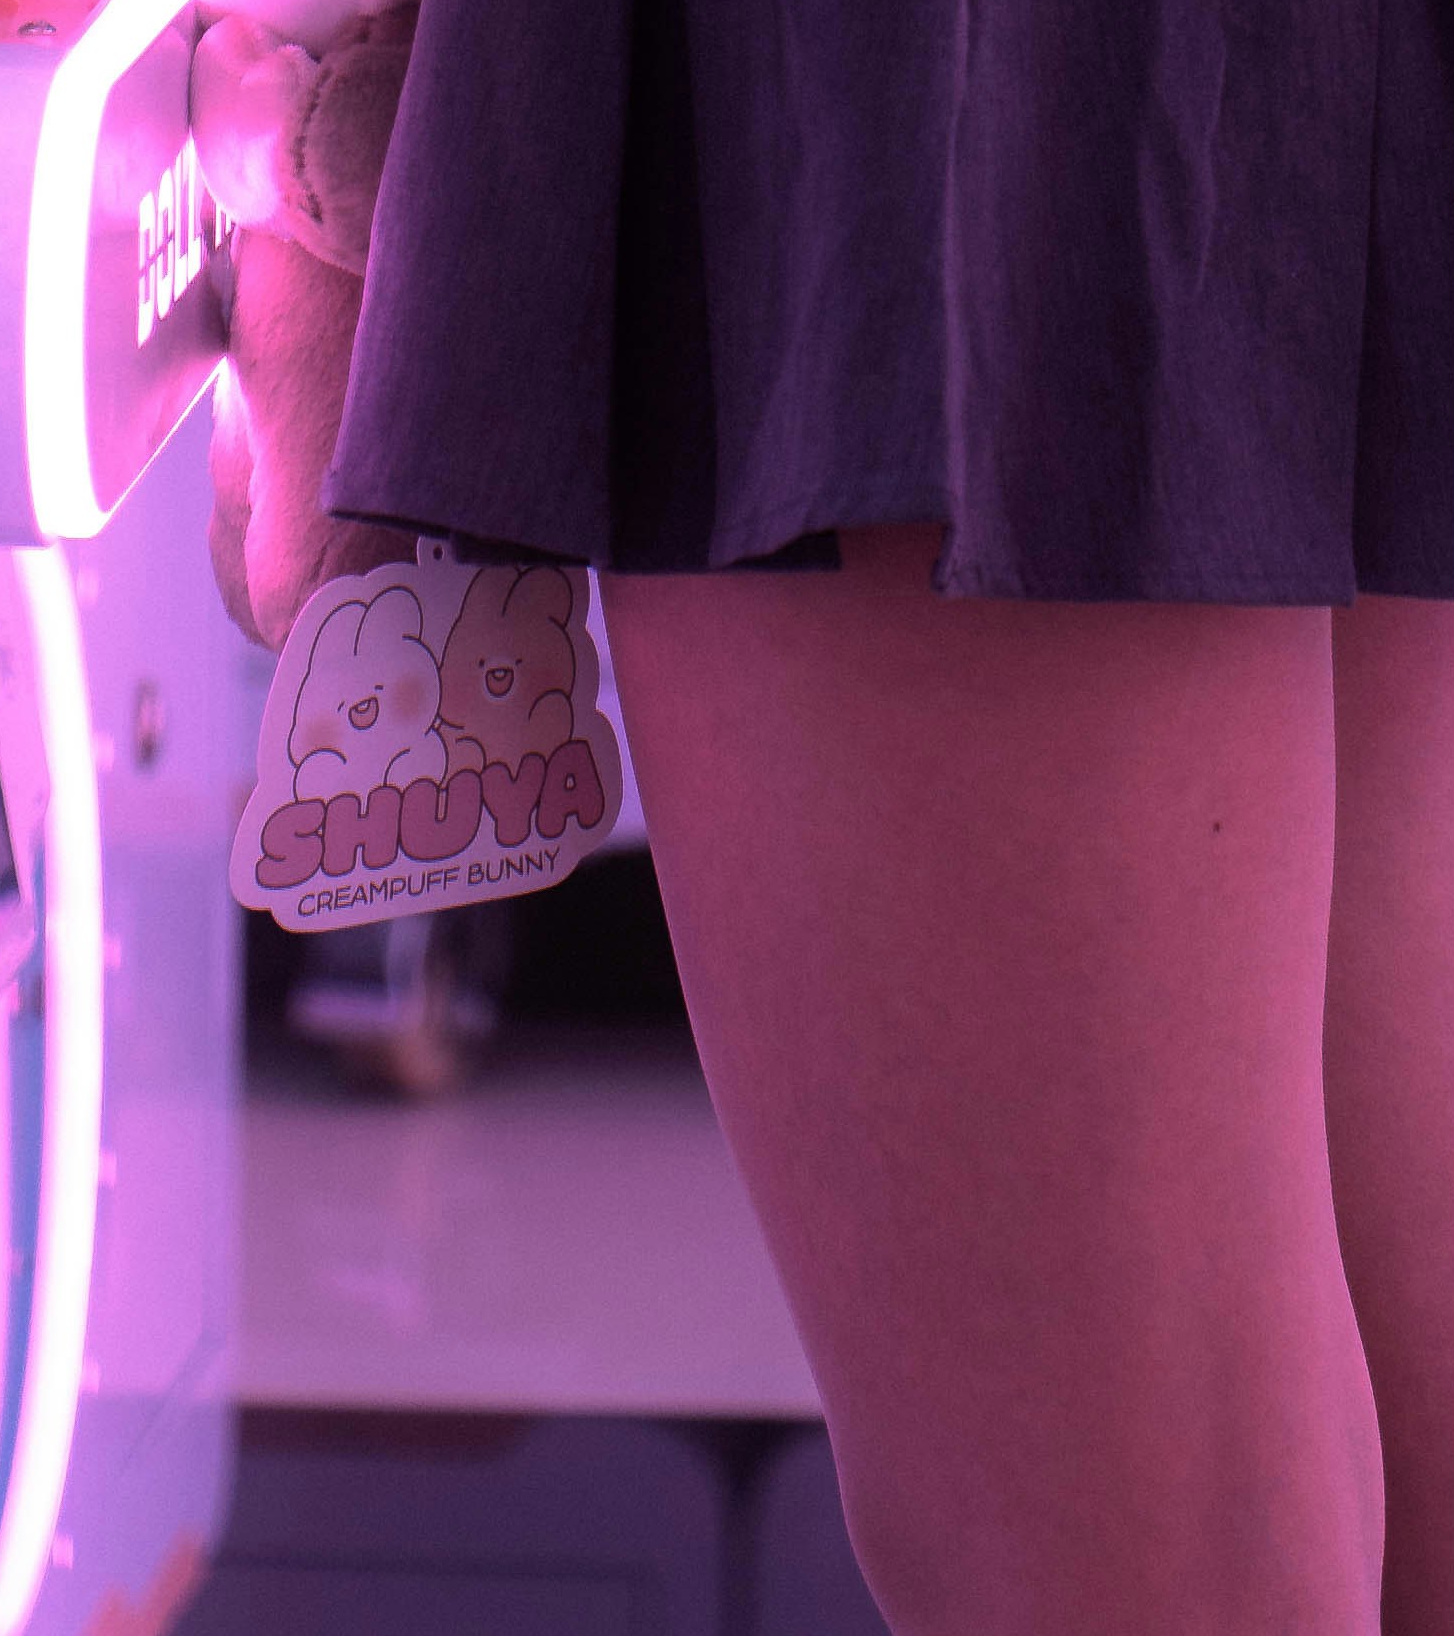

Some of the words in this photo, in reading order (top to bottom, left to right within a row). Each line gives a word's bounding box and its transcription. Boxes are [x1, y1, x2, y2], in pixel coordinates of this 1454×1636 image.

[255, 739, 606, 890] SHUYA
[296, 865, 460, 919] CREAMPUFF
[466, 845, 562, 888] BUNNY
